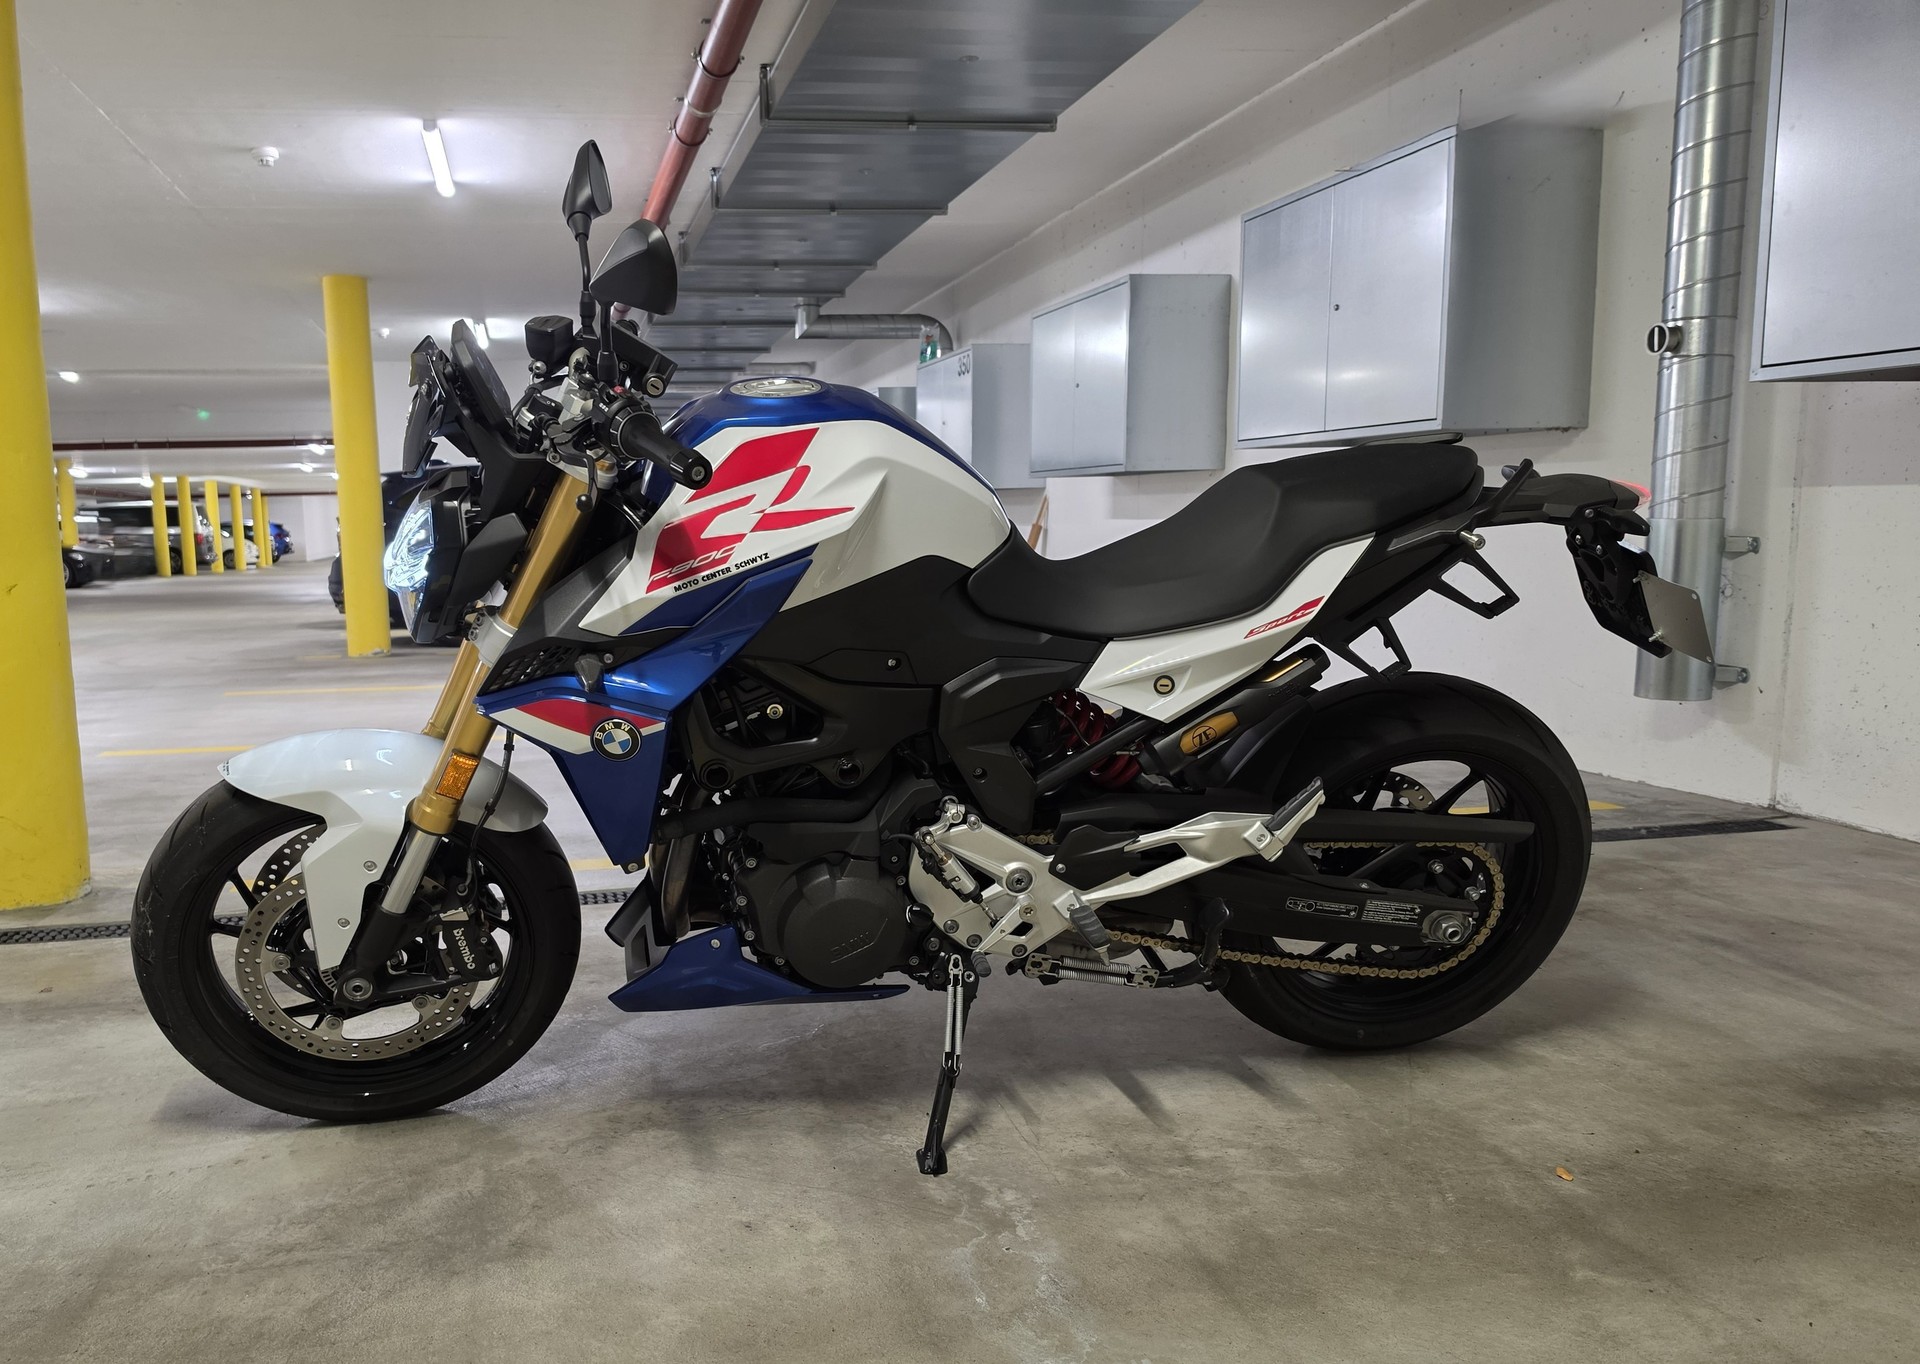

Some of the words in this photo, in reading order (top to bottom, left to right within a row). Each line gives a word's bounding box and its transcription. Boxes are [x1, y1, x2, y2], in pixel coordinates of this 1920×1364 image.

[674, 579, 699, 593] MOTO
[701, 567, 732, 583] CENTER
[734, 552, 770, 571] SCHWYZ
[595, 722, 631, 740] BMW
[1193, 727, 1212, 747] ZF
[452, 927, 476, 970] brembo
